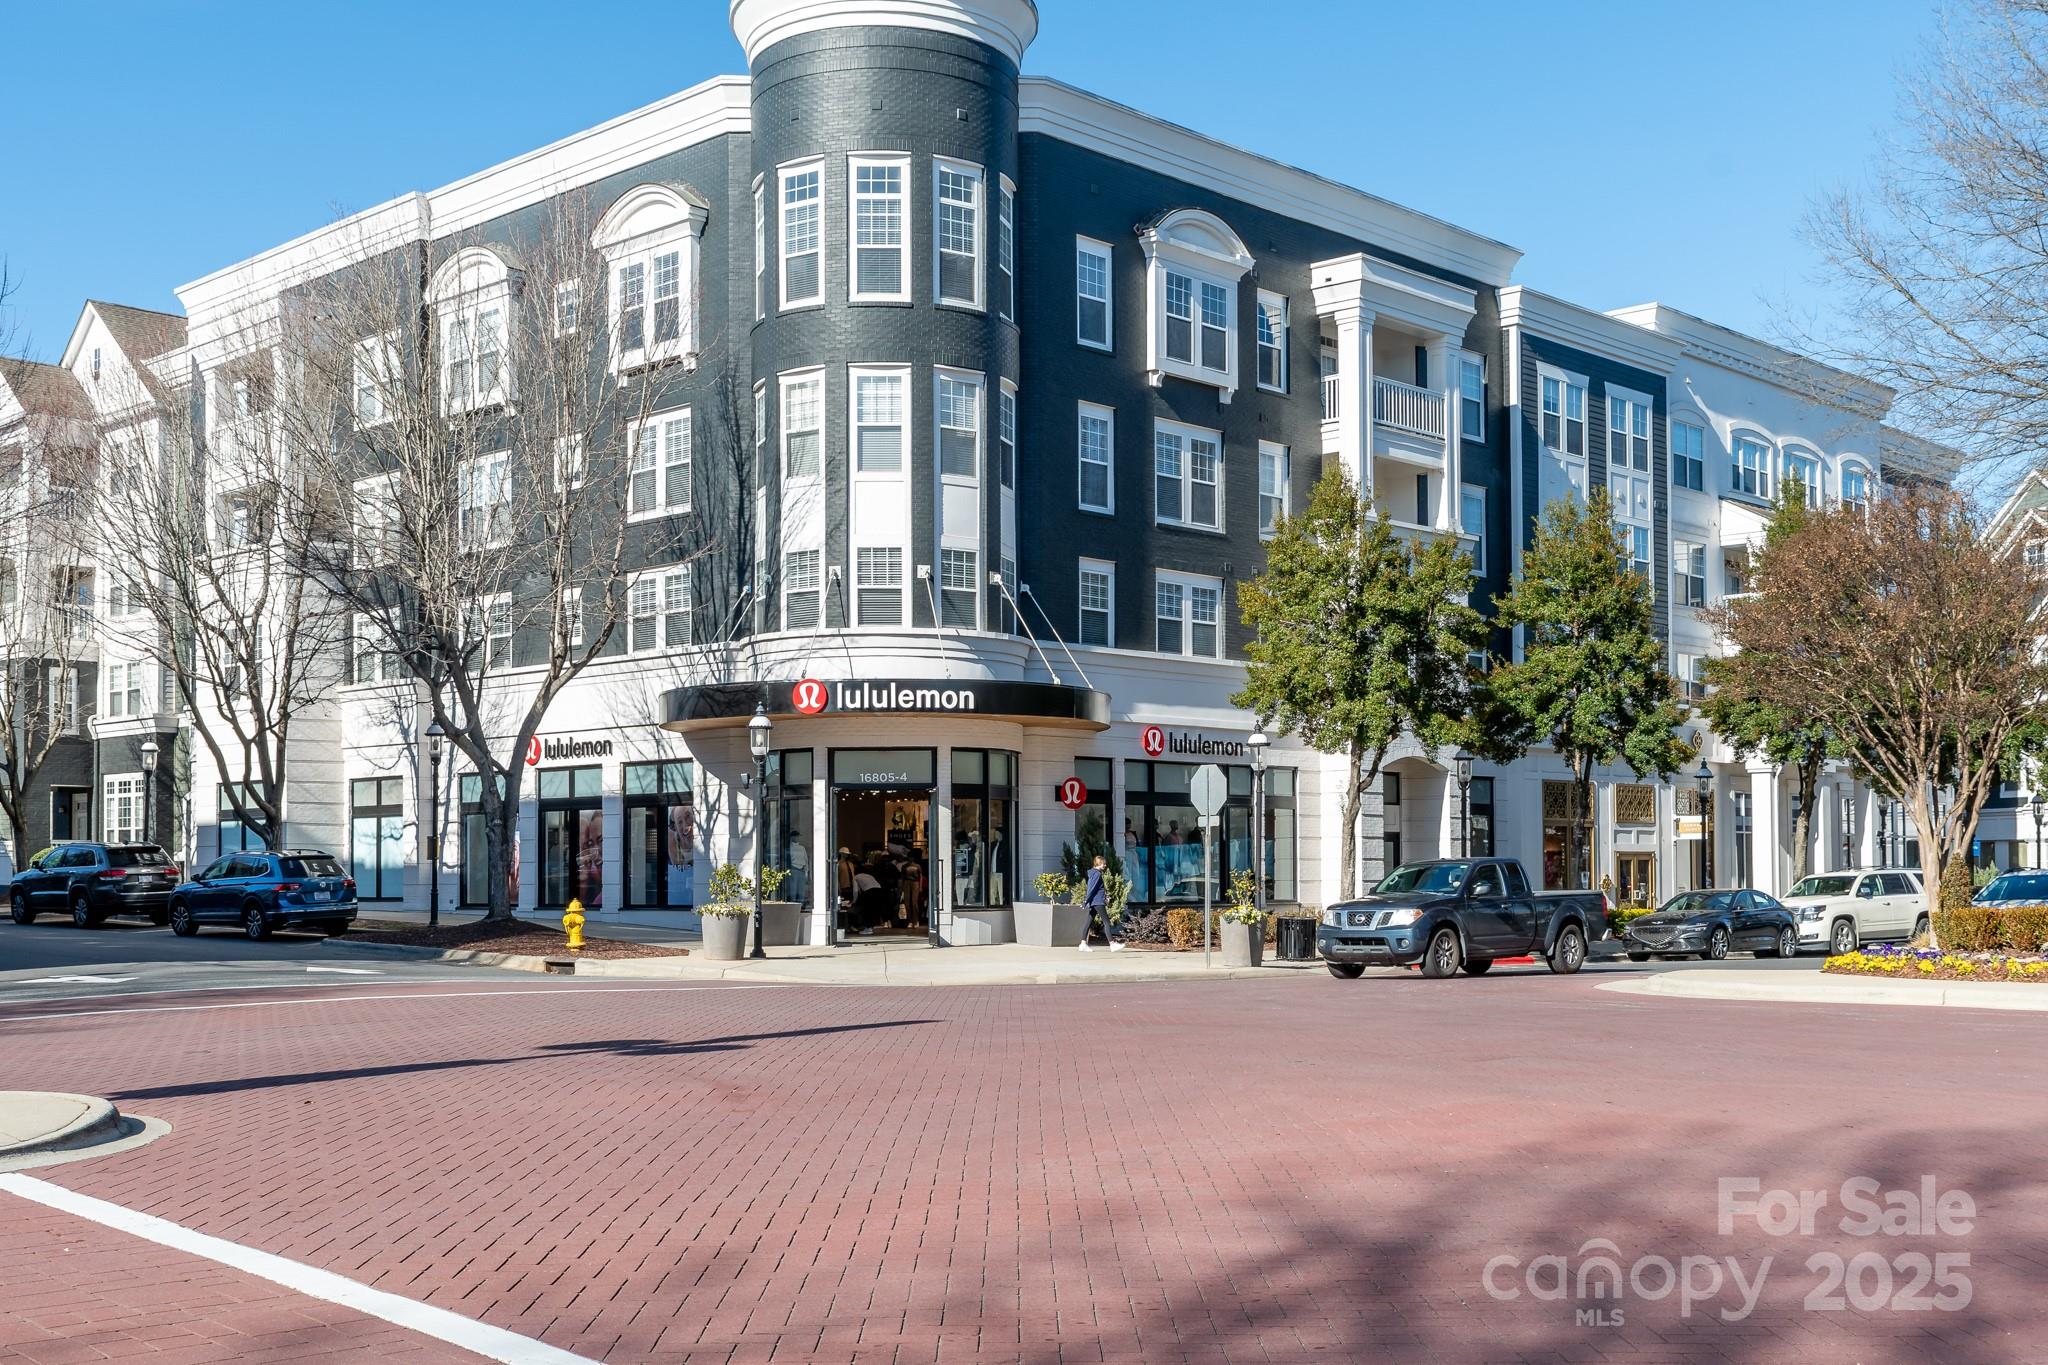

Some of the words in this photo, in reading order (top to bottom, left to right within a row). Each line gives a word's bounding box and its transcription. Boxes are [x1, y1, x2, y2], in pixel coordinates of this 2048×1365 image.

[837, 682, 975, 710] lululemon
[544, 737, 613, 759] lululemon
[1169, 732, 1243, 756] lululemon
[860, 773, 908, 783] 16805-4
